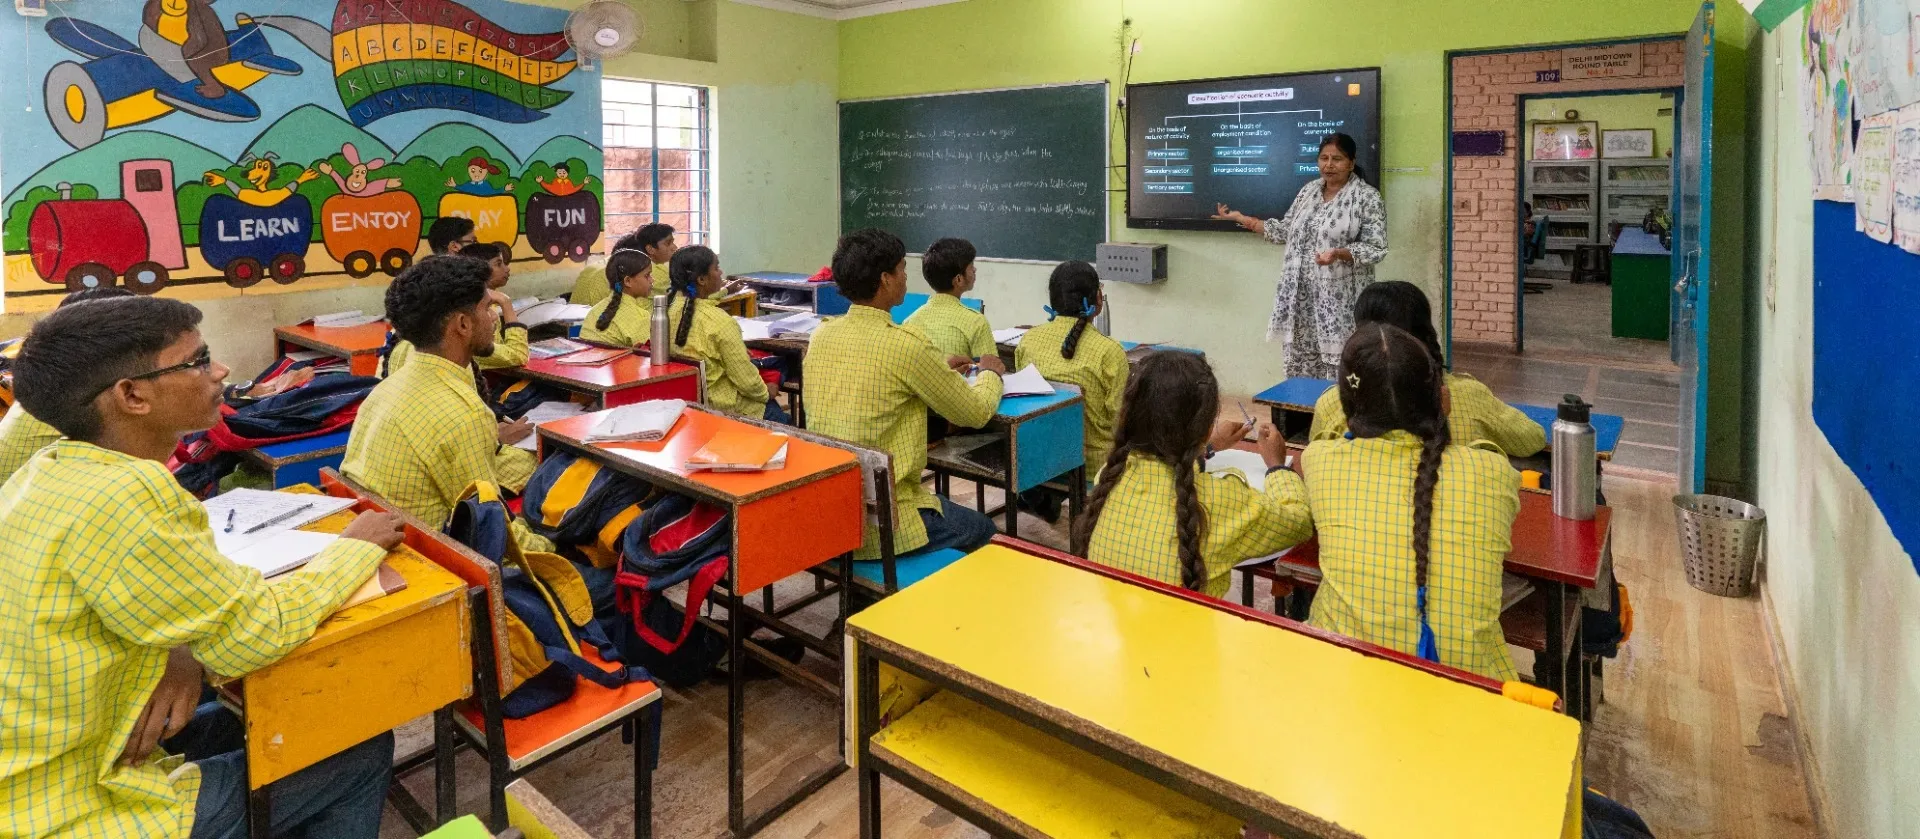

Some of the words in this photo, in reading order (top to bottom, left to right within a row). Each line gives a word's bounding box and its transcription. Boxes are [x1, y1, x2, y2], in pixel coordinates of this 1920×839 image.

[363, 4, 378, 20] 2
[464, 19, 475, 31] 6
[485, 28, 494, 39] 7
[508, 37, 516, 49] 8
[528, 42, 536, 53] 9
[342, 46, 353, 62] A
[367, 40, 381, 56] B
[392, 37, 402, 51] C
[415, 38, 427, 51] D
[436, 39, 446, 54] E
[458, 42, 468, 55] F
[480, 48, 493, 62] G
[502, 58, 513, 70] H
[524, 63, 533, 76] I
[544, 66, 553, 78] J
[347, 78, 362, 97] K
[373, 70, 385, 84] L
[393, 67, 409, 80] M
[417, 67, 428, 78] N
[436, 68, 446, 78] O
[457, 70, 465, 80] P
[480, 75, 489, 85] Q
[504, 83, 513, 93] R
[526, 91, 535, 104] S
[541, 93, 552, 103] T
[1540, 73, 1555, 82] 109
[359, 106, 373, 118] U
[384, 96, 394, 108] V
[401, 92, 416, 103] W
[423, 91, 433, 105] X
[440, 91, 450, 106] Y
[459, 95, 469, 105] Z
[1303, 127, 1336, 135] ownership
[1213, 166, 1248, 174] Unorganised
[217, 217, 300, 242] LEARN
[332, 211, 411, 232] ENJOY
[544, 208, 586, 228] FUN
